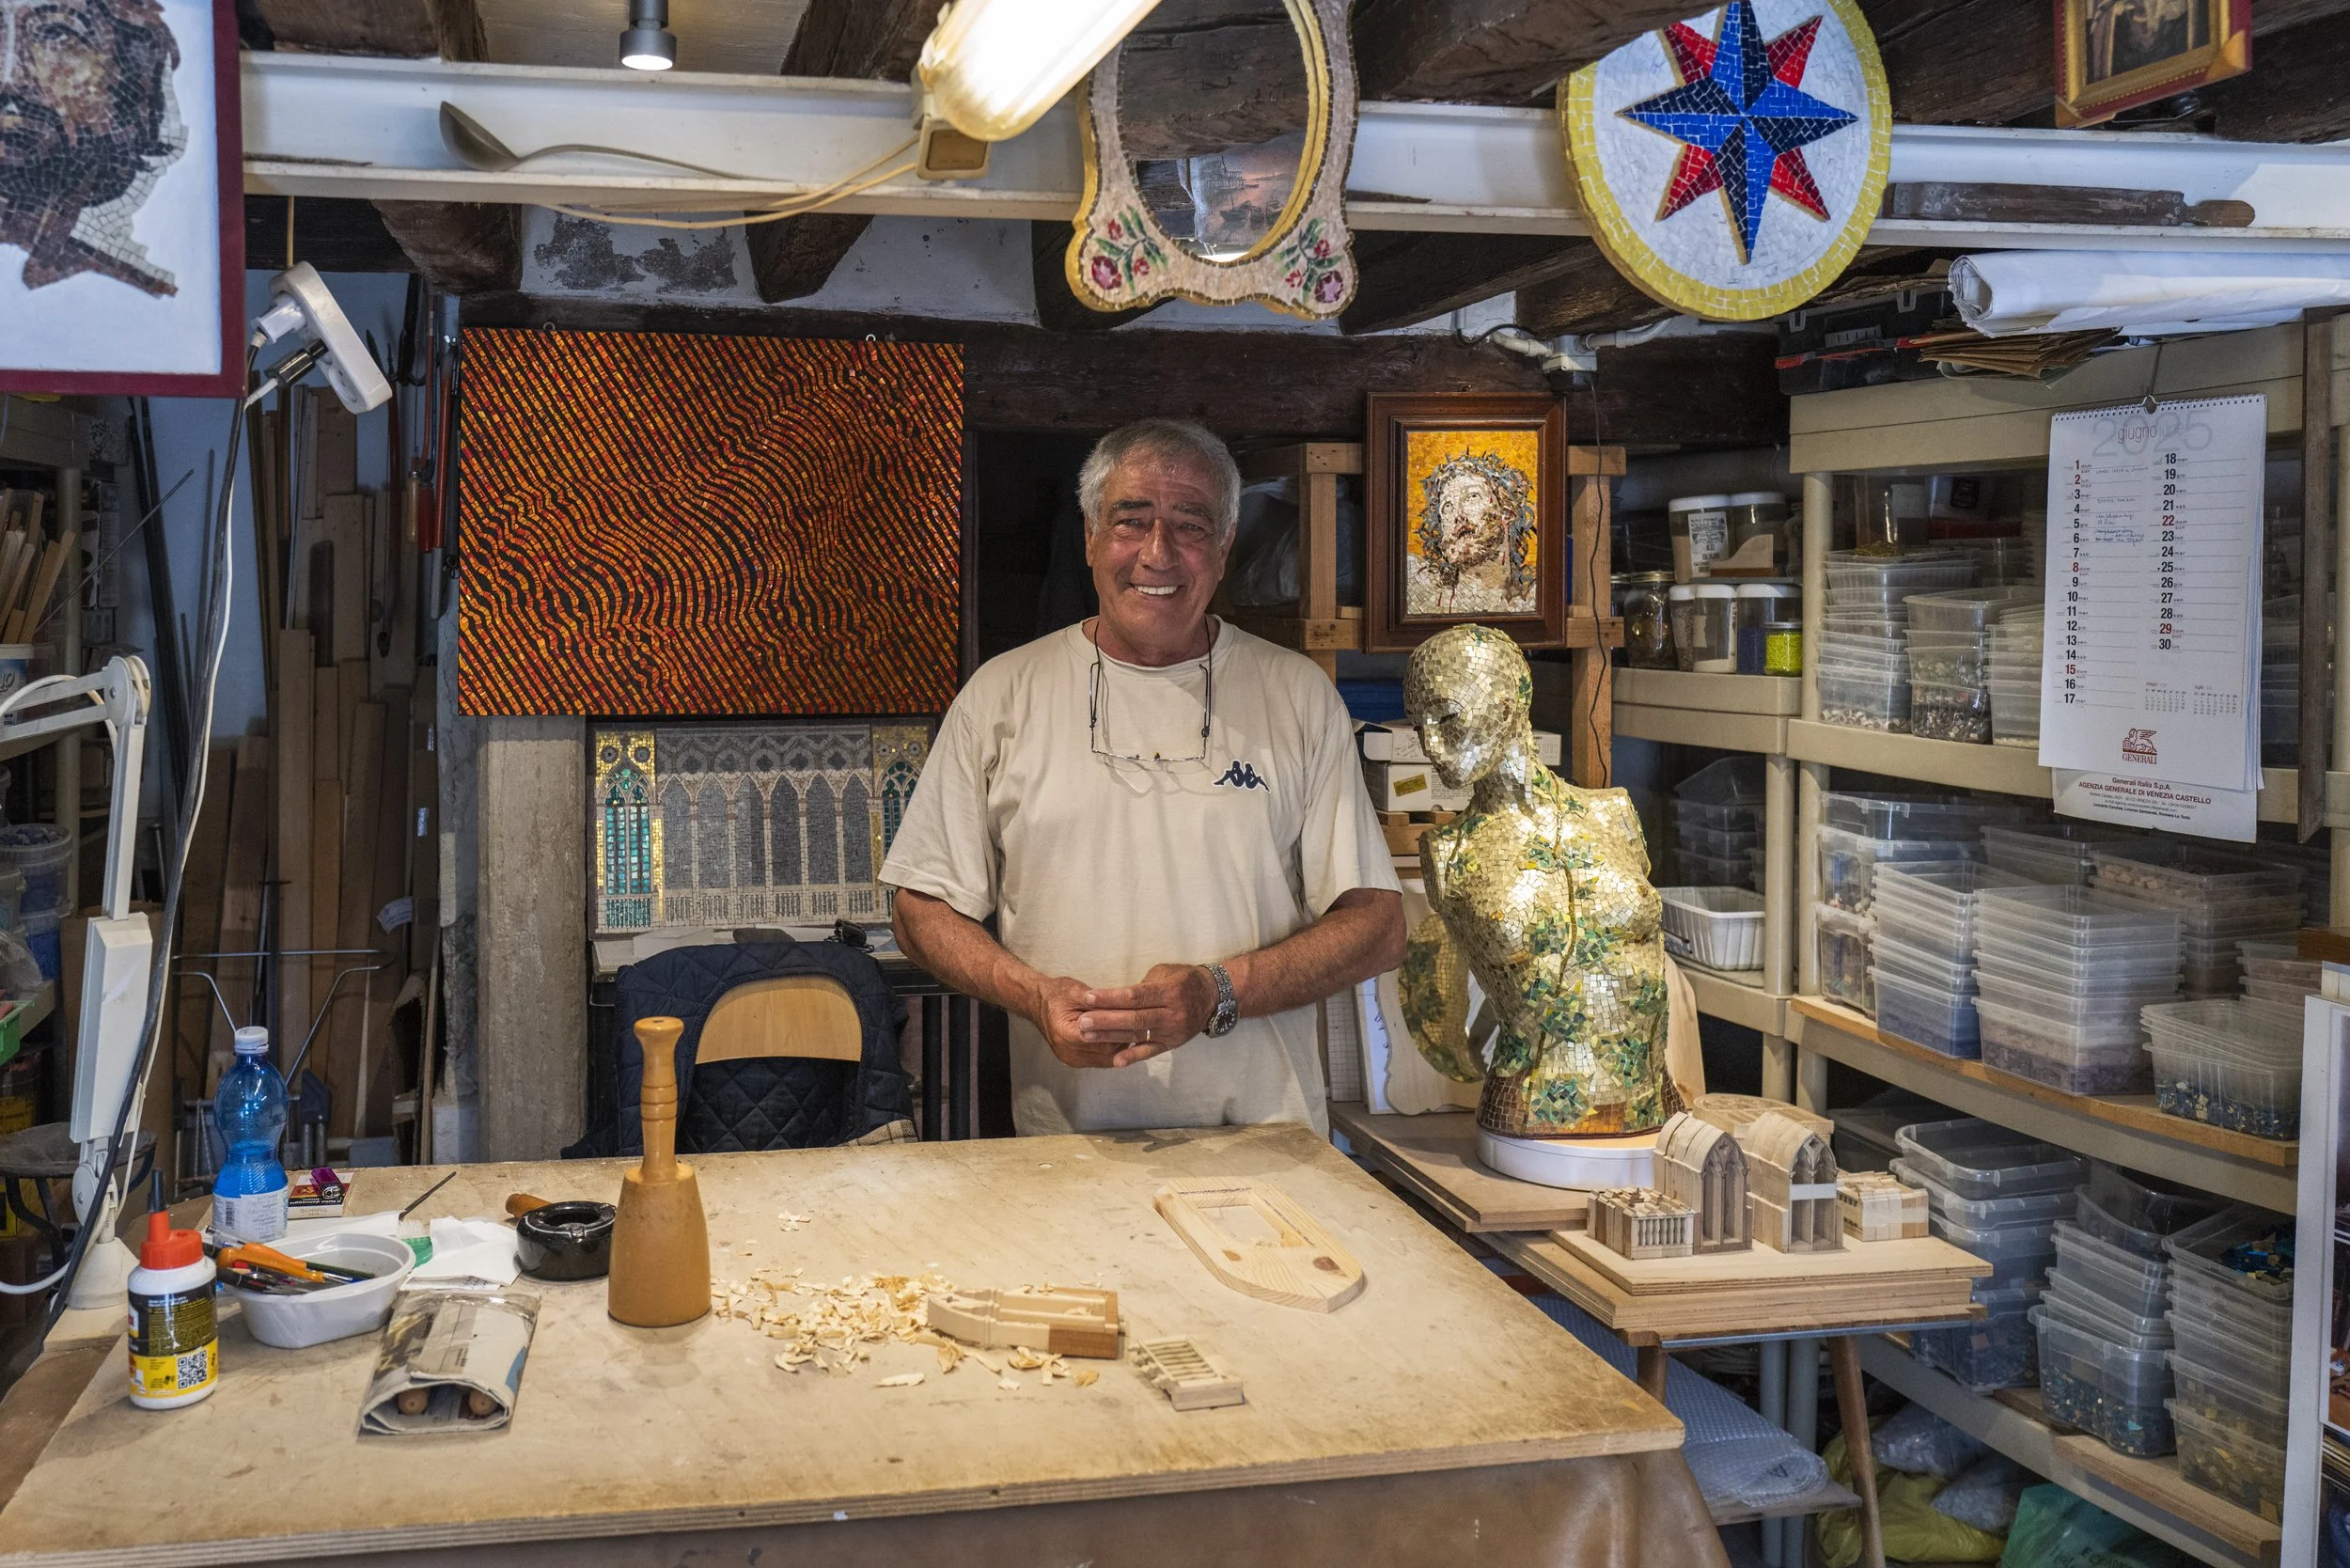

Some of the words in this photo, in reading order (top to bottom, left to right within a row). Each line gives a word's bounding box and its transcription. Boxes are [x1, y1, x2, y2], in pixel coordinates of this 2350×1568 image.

[2092, 409, 2212, 457] 2025
[2117, 425, 2156, 445] giugno
[2166, 453, 2176, 464] 18
[2076, 460, 2079, 470] 1
[2164, 468, 2176, 479] 19
[2075, 474, 2081, 485] 2
[2075, 489, 2080, 499] 3
[2164, 484, 2175, 495] 20
[2074, 504, 2079, 513] 4
[2163, 500, 2173, 510] 21
[2074, 519, 2079, 528] 5
[2162, 515, 2174, 526] 22
[2074, 533, 2079, 543] 6
[2162, 531, 2174, 541] 23
[2074, 547, 2079, 557] 7
[2162, 546, 2173, 557] 24
[2073, 562, 2078, 572] 8
[2161, 562, 2173, 572] 25
[2072, 577, 2078, 587] 9
[2161, 577, 2173, 588] 26
[2068, 591, 2077, 602] 10
[2161, 592, 2173, 604] 27
[2067, 605, 2076, 616] 11
[2161, 608, 2172, 619] 28
[2066, 620, 2077, 631] 12
[2159, 623, 2171, 634] 29
[2066, 635, 2076, 645] 13
[2159, 639, 2170, 650] 30
[2066, 650, 2076, 660] 14
[2065, 664, 2076, 674] 15
[2065, 679, 2076, 689] 16
[2064, 694, 2076, 703] 17
[2123, 754, 2157, 765] GENERALI
[2112, 777, 2137, 786] Generali
[2078, 781, 2104, 791] AGENZIA
[2104, 785, 2137, 794] GENERALE
[2146, 791, 2174, 800] VENEZIA
[2175, 794, 2211, 804] CASTELLO
